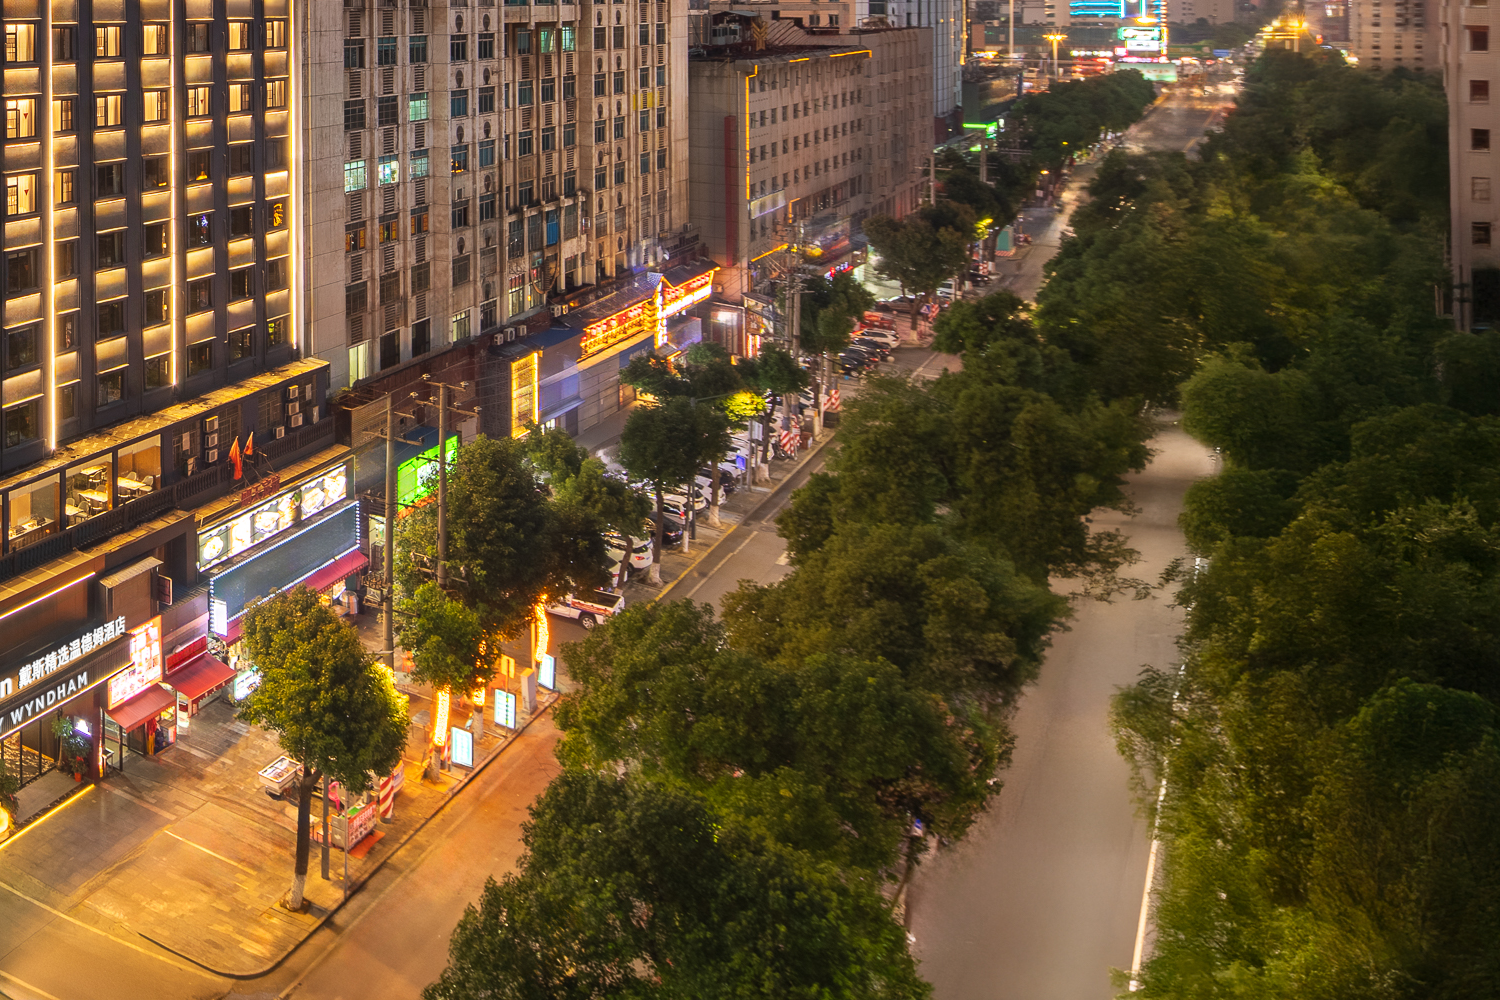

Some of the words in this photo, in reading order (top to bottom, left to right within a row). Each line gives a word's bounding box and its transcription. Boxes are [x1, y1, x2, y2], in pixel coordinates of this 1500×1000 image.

[18, 616, 126, 689] 戴斯精选温德姆酒店
[10, 671, 88, 725] WYNDHAM
